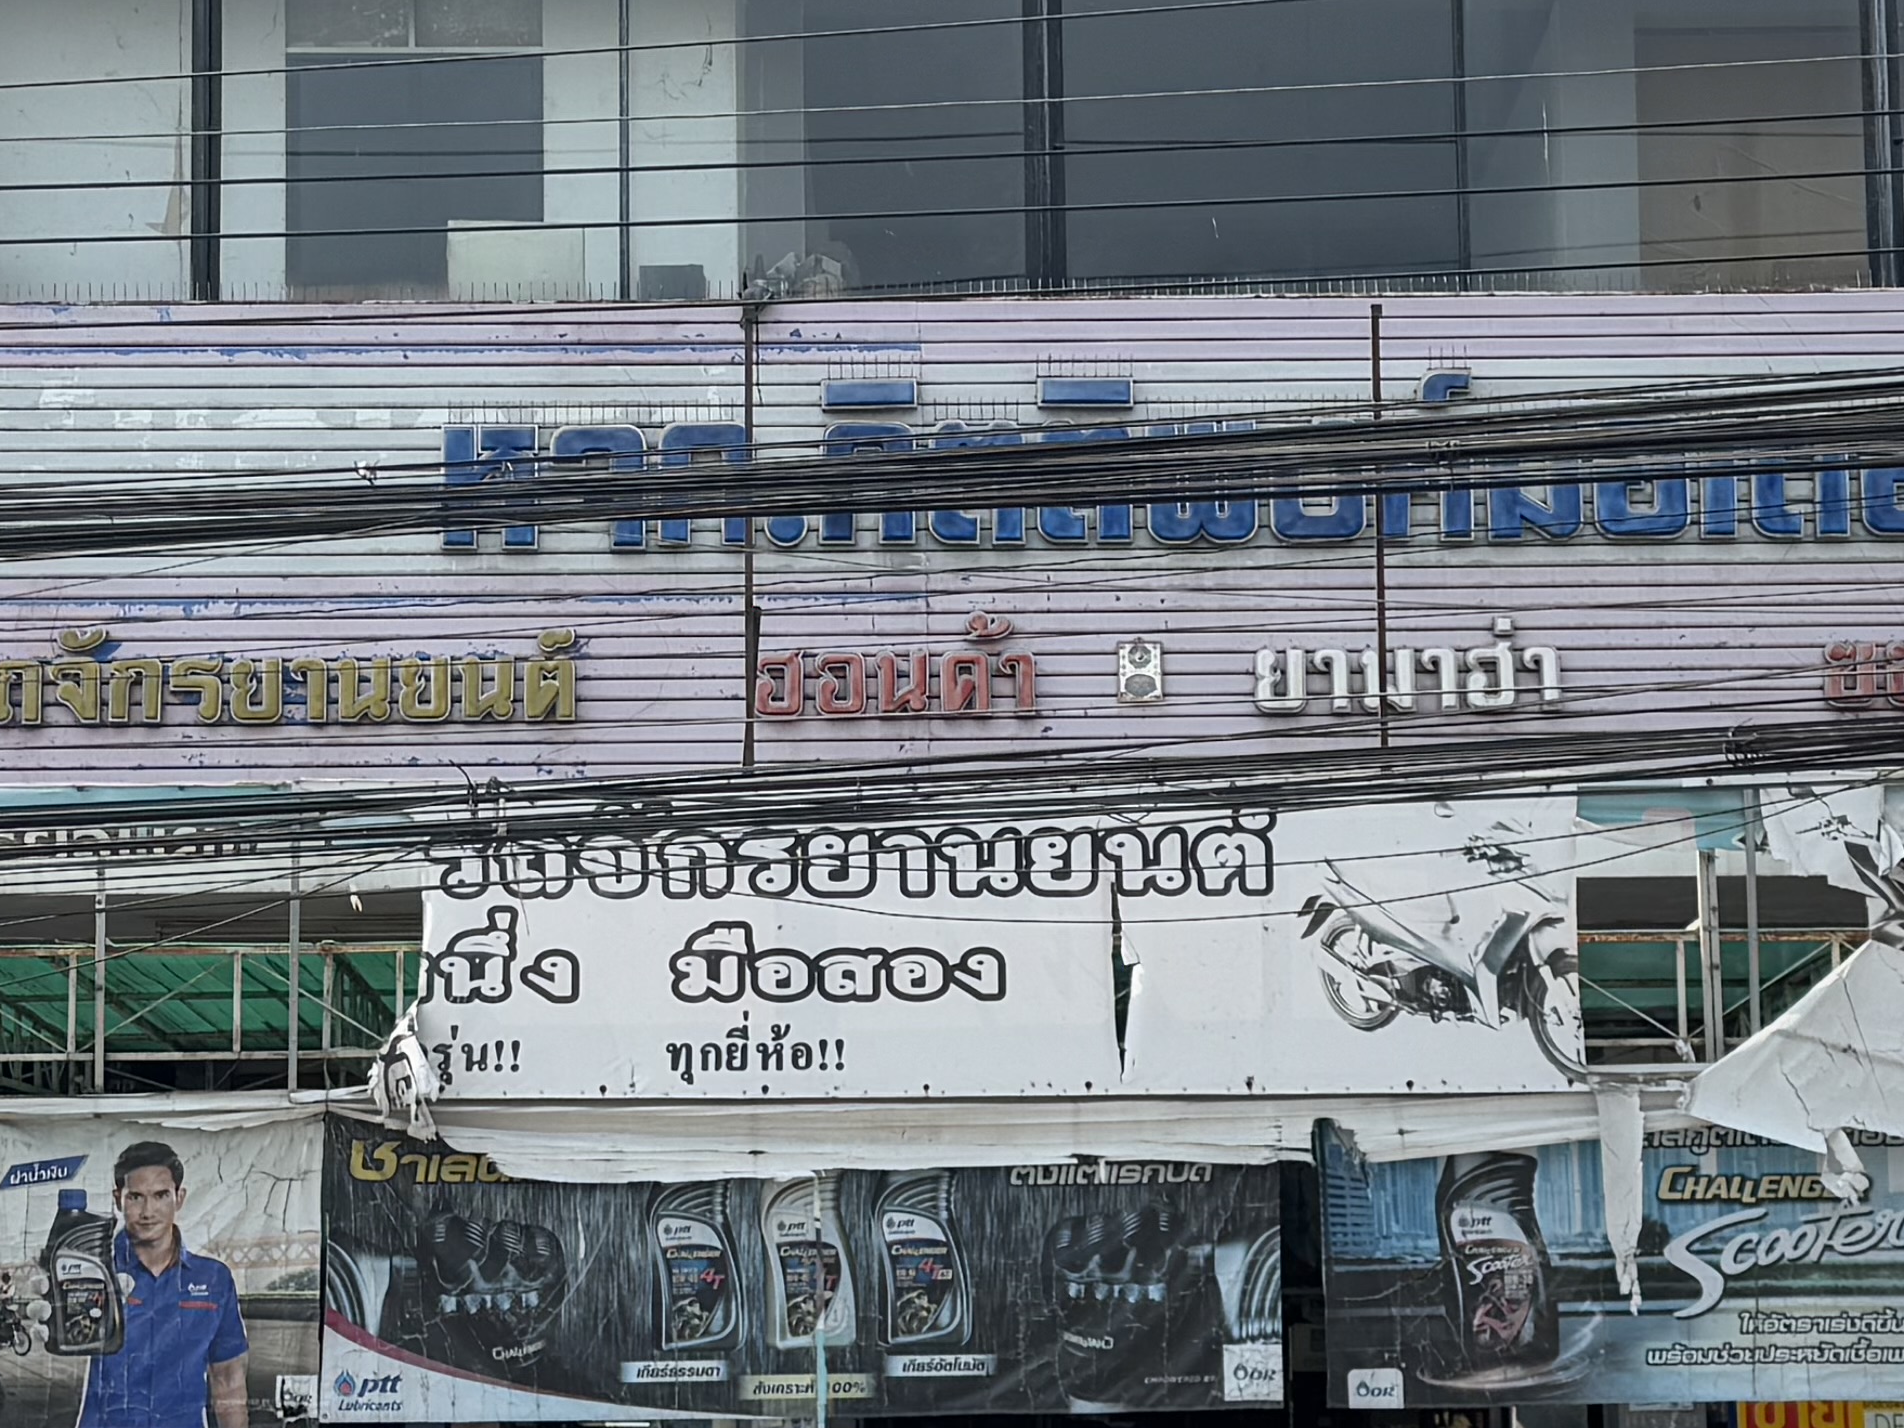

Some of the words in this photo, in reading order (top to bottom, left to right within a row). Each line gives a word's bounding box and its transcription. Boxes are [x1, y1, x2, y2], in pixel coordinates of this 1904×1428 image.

[755, 612, 1037, 718] ฮอนด้า
[1254, 617, 1561, 713] ยามาฮ่า
[422, 905, 580, 1004] นึ่ง
[669, 921, 1006, 1003] มือสอง
[424, 1025, 521, 1085] รุ่น!!
[665, 1011, 845, 1084] ทุกยี่ห้อ!!
[10, 1163, 68, 1184] ฝาน้ำเงิน
[1658, 1165, 1870, 1203] CHALLENG
[358, 1374, 403, 1398] ptt
[338, 1400, 402, 1413] Lubricants
